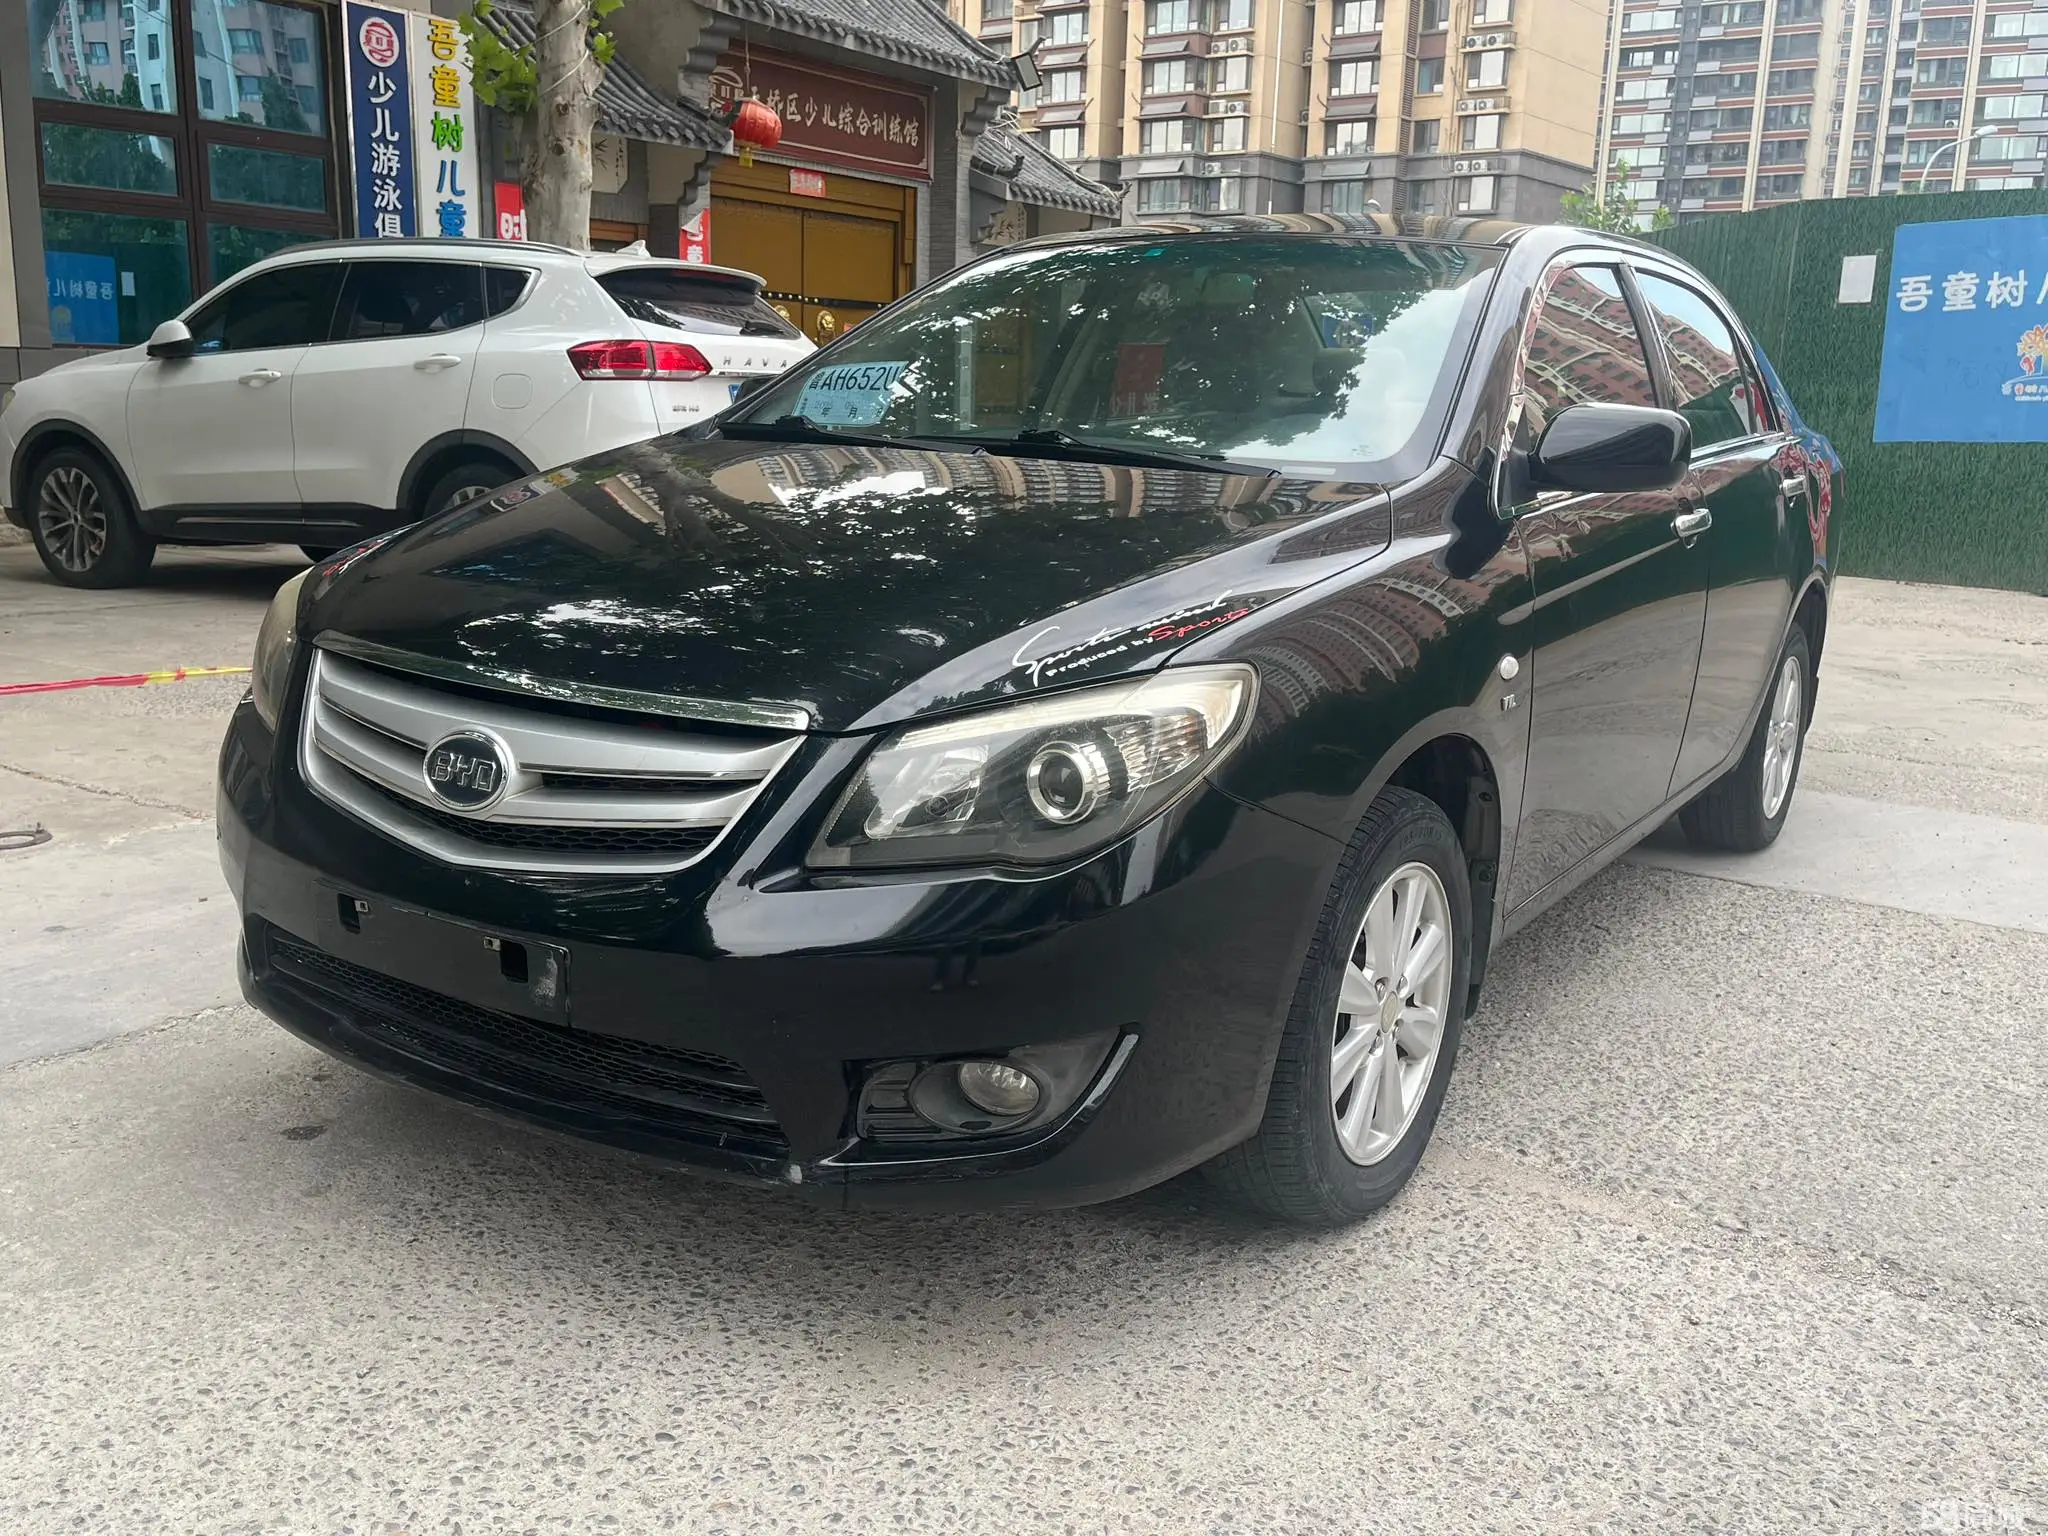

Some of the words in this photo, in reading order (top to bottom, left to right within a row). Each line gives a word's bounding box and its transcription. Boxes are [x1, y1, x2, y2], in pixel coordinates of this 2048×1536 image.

[367, 71, 404, 238] 少儿游泳俱
[427, 19, 467, 237] 吾童树儿童
[1045, 645, 1128, 677] produced
[1131, 636, 1154, 646] by
[1148, 608, 1249, 641] Sports
[431, 749, 497, 792] BYD
